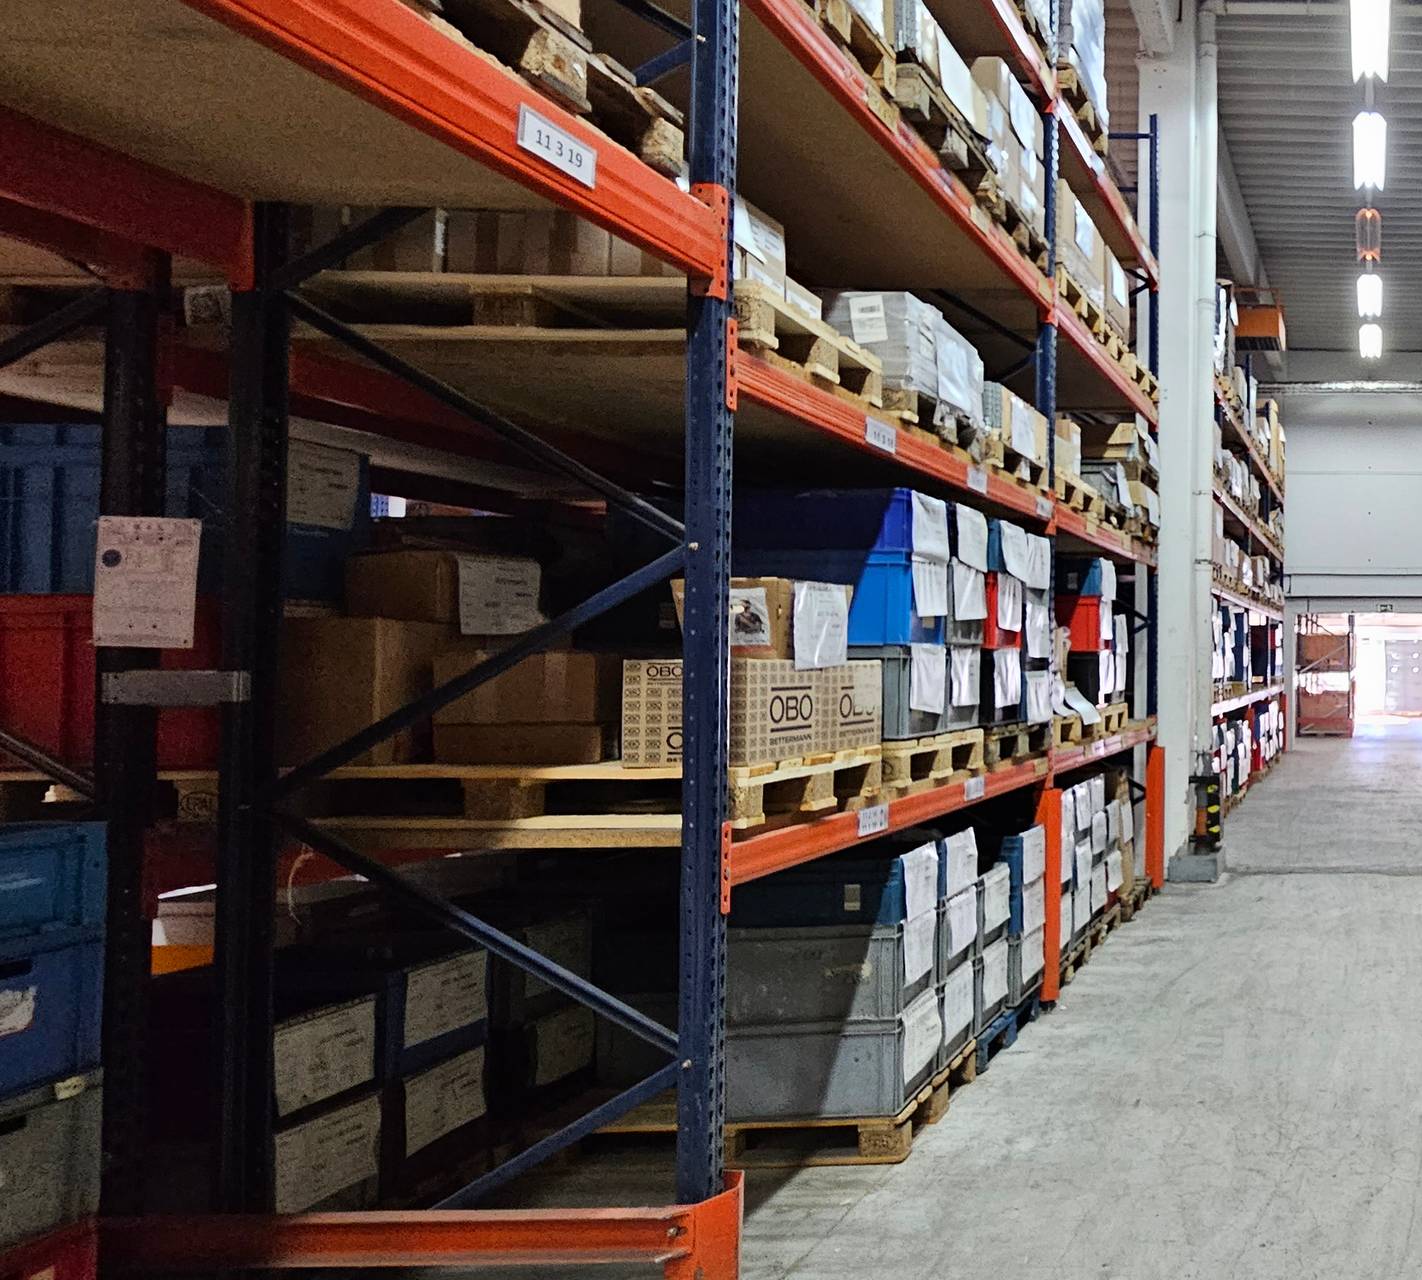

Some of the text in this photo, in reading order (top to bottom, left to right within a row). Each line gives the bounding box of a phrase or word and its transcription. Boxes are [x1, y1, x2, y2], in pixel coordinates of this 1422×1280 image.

[536, 129, 583, 168] 11 3 19
[769, 694, 813, 723] OBO
[769, 733, 812, 746] BETTERMANN
